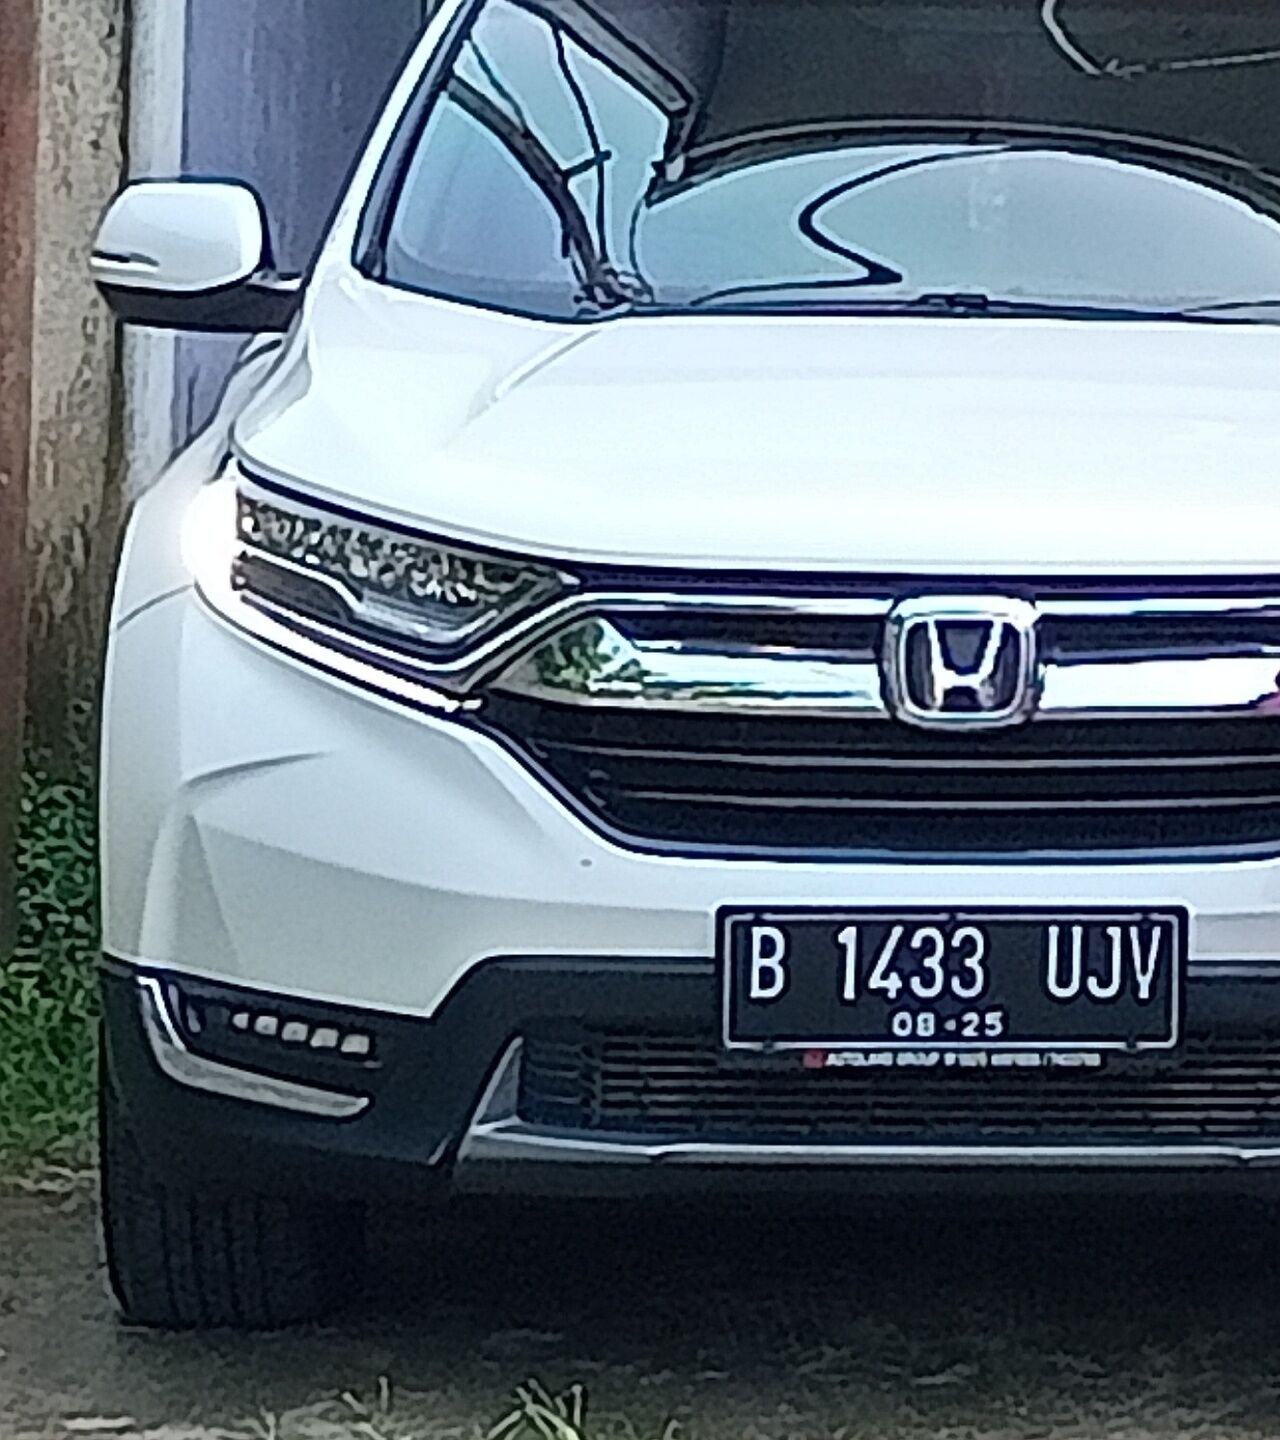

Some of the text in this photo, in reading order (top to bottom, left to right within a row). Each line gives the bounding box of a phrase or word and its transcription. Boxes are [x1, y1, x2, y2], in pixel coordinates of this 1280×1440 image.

[749, 925, 1162, 1001] B 1433 UJV
